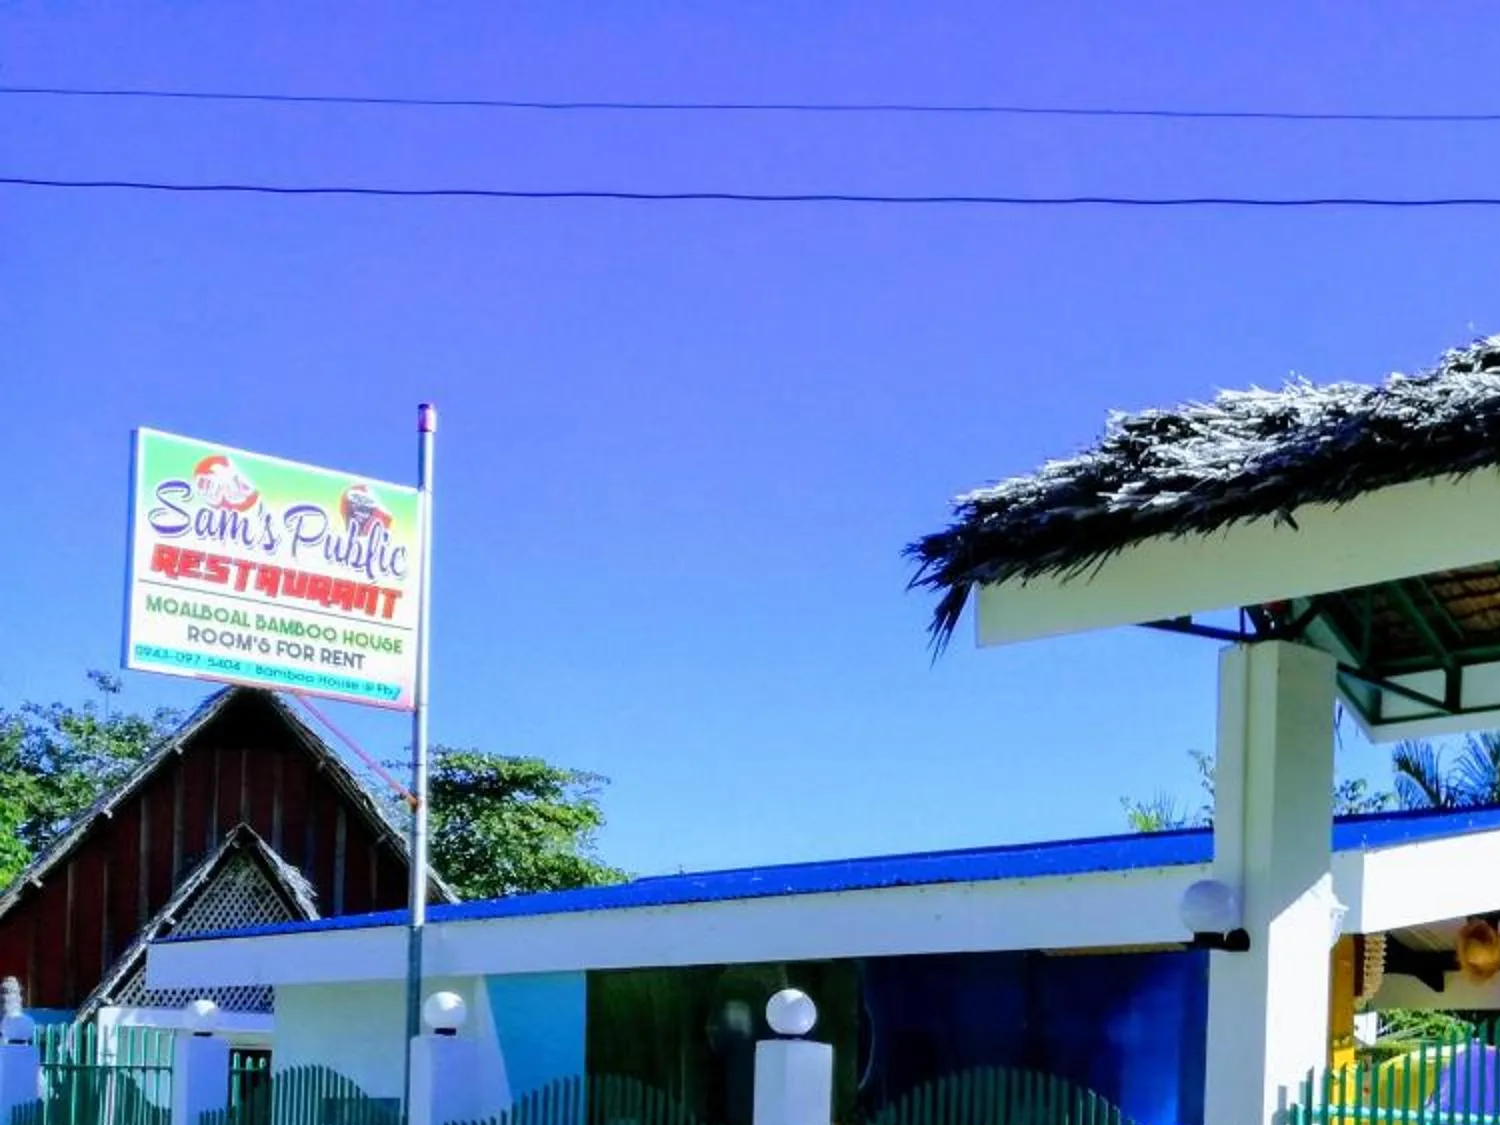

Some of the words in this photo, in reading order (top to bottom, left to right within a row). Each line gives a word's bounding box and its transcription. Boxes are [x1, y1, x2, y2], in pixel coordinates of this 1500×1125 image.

[149, 480, 275, 551] Sam's
[283, 505, 405, 580] Public
[150, 543, 402, 619] RESTAURANT
[145, 594, 251, 627] MOALBOAL
[256, 613, 337, 642] BAMBOO
[343, 629, 403, 655] HOUSE
[187, 624, 271, 655] ROOM'S
[276, 639, 315, 662] FOR
[320, 647, 366, 669] RENT
